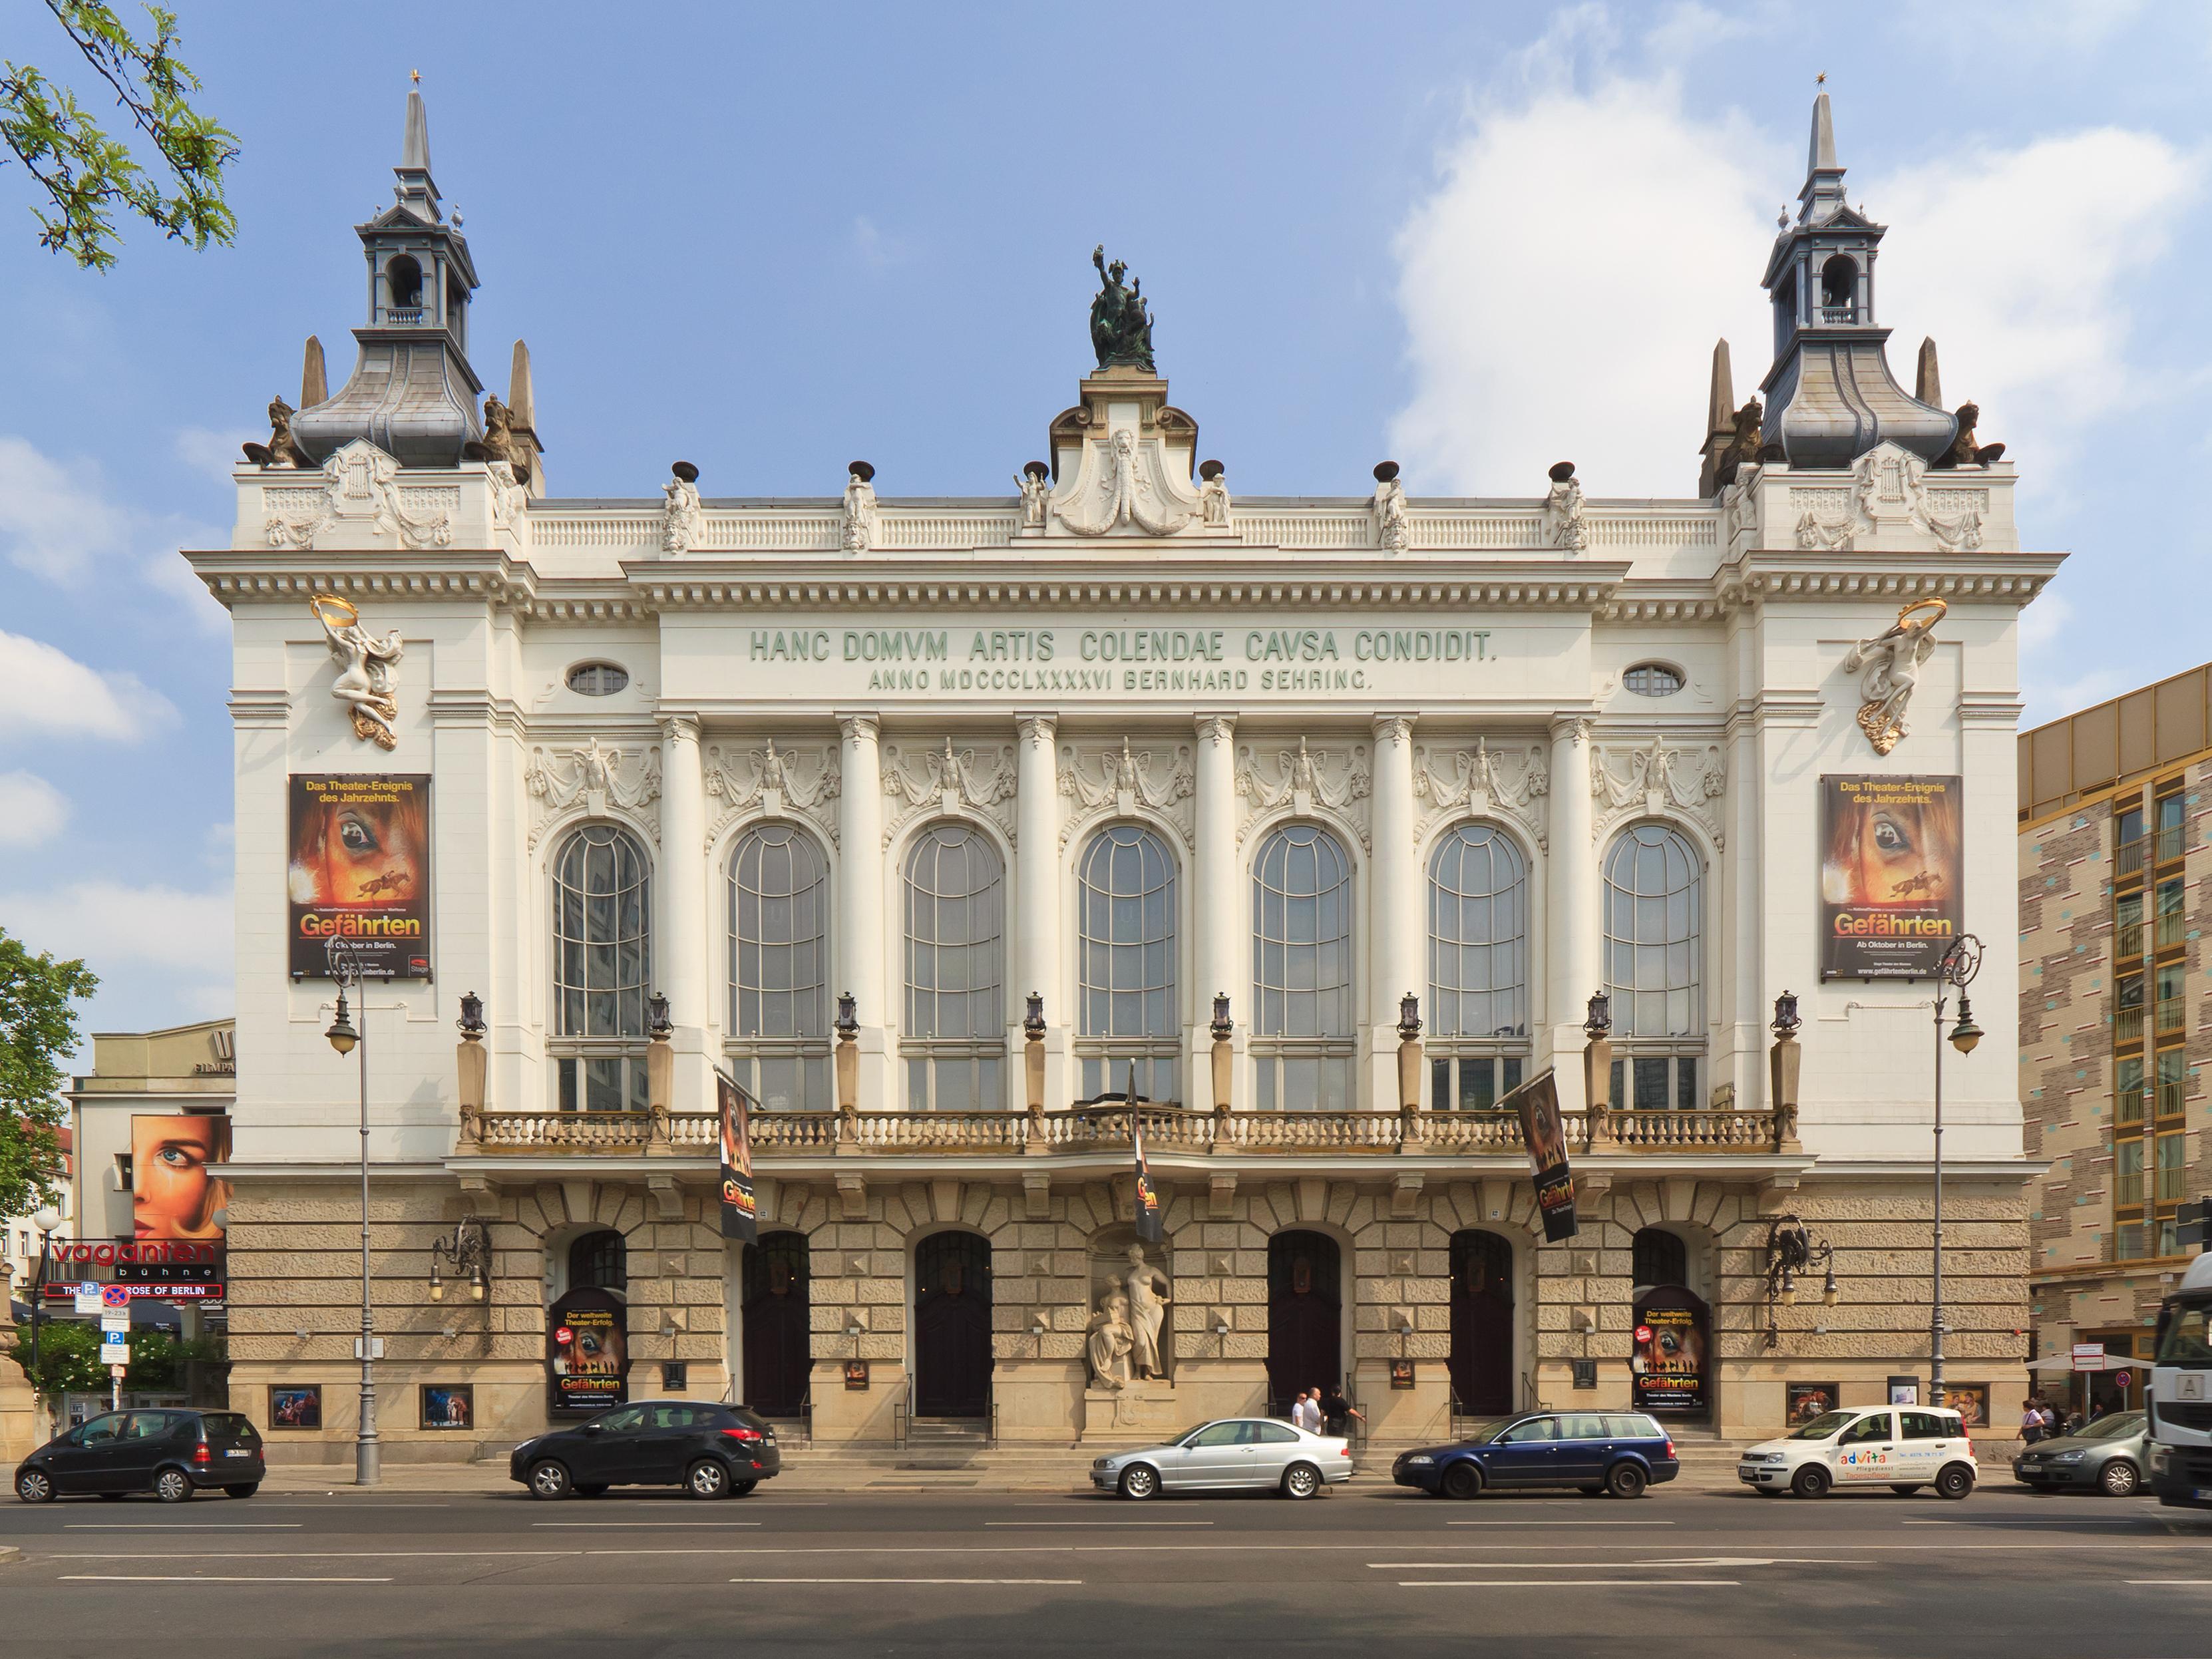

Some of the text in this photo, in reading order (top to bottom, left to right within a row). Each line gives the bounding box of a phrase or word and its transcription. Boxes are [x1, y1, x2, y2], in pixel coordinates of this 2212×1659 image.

[751, 631, 1497, 661] HANC DOMVM ARTIS COLENDAE CAVSA CONDIDIT.
[868, 669, 930, 690] ANNO
[940, 669, 1112, 690] MDCCCLXXXXVI
[1124, 669, 1248, 690] BERNHARD
[306, 781, 413, 792] Das Theater-Ereignis
[1840, 782, 1945, 793] Das Theater-Ereignis
[319, 793, 400, 803] des Jahrzehnts.
[1853, 794, 1933, 804] des Jahrzehnts.
[300, 914, 421, 936] Gefährten
[1834, 913, 1952, 936] Gefährten
[52, 1242, 214, 1267] vaganten
[119, 1268, 212, 1276] bühne
[85, 1284, 94, 1294] P
[110, 1333, 120, 1343] P
[561, 1378, 620, 1389] Gefährten
[1640, 1377, 1698, 1388] Gefährten
[1841, 1451, 1886, 1465] advita
